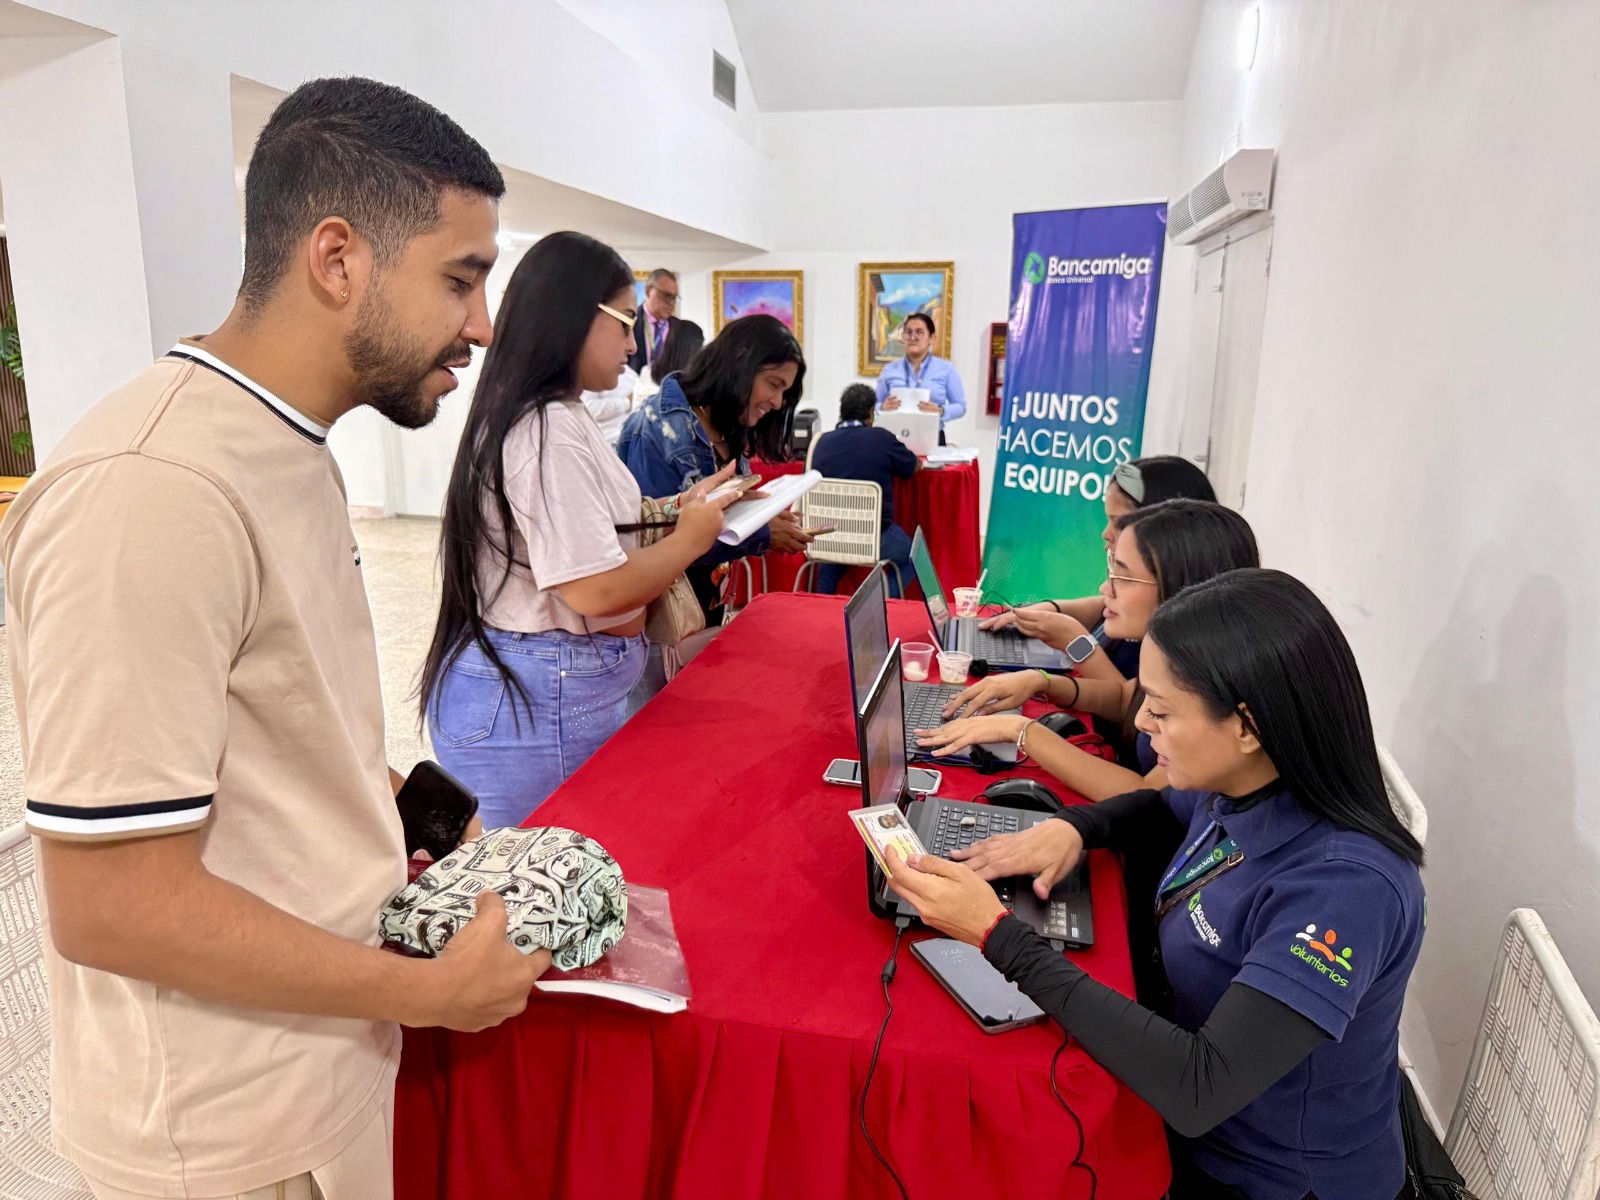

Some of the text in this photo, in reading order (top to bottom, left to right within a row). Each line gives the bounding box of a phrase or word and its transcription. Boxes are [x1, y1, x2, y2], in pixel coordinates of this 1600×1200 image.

[1047, 252, 1151, 279] Bancamiga
[1010, 391, 1120, 426] ¡JUNTOS
[997, 426, 1133, 465] HACEMOS
